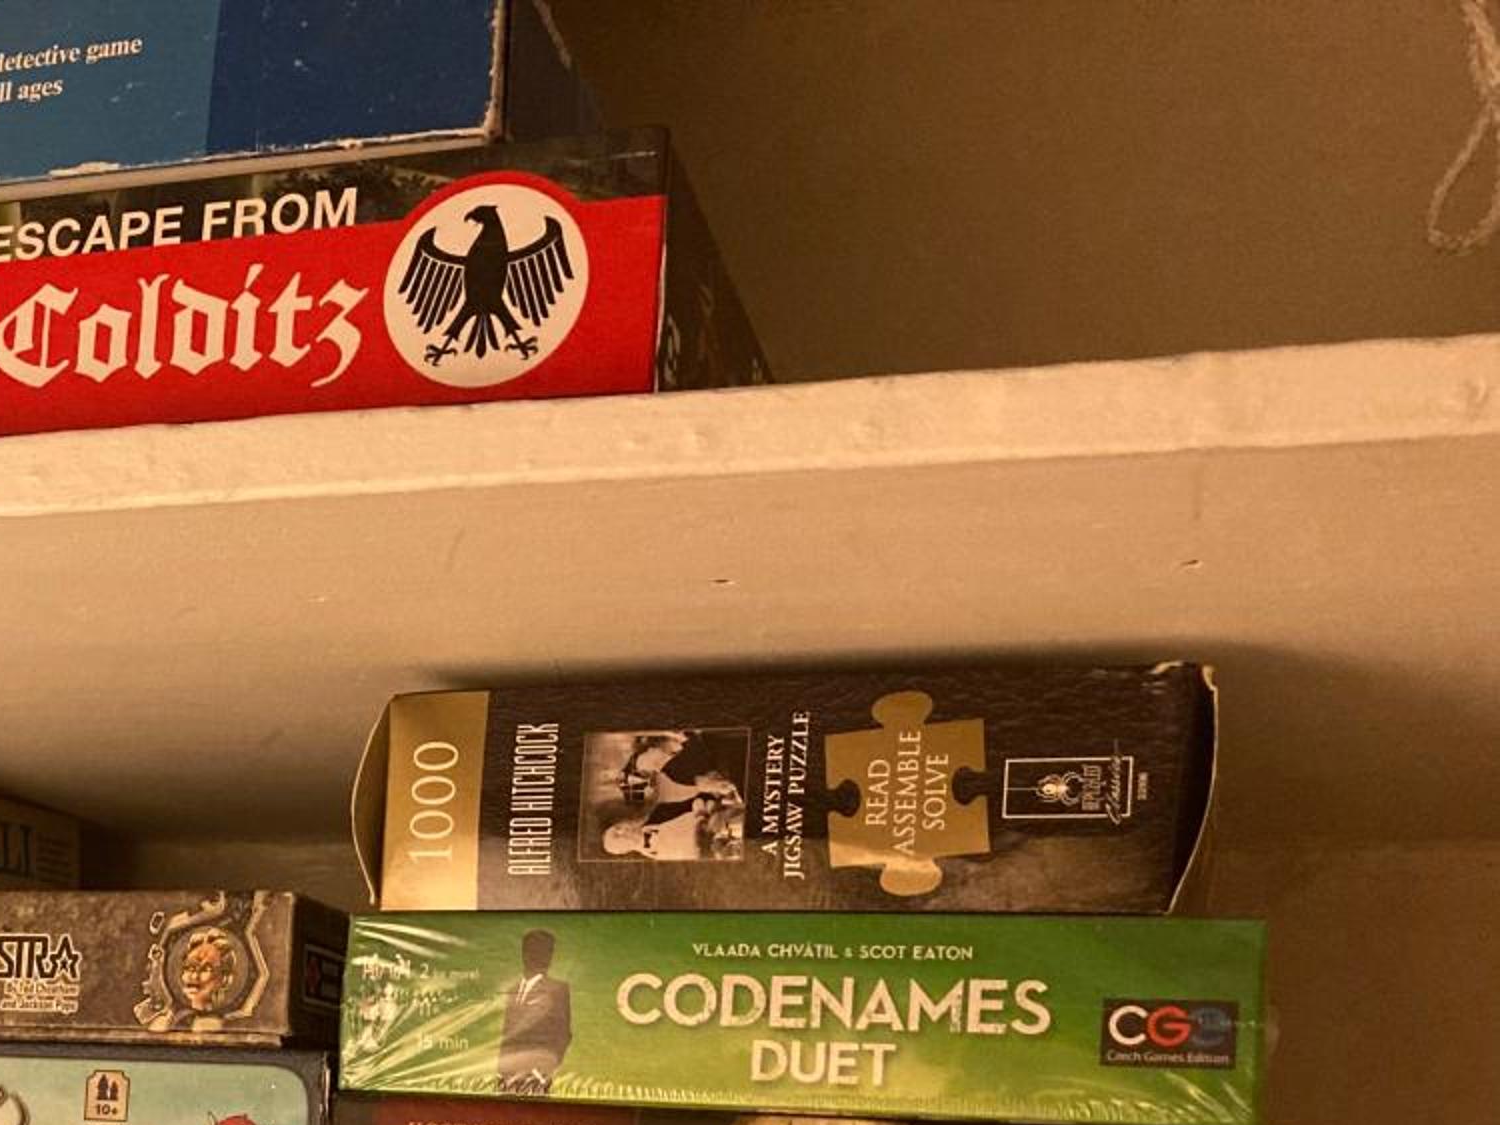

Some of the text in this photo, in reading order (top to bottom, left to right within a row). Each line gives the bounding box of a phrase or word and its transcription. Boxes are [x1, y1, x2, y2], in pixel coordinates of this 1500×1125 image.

[86, 37, 143, 62] game
[18, 77, 64, 102] ages
[202, 187, 359, 241] FROM
[406, 741, 460, 866] 1000
[507, 722, 560, 876] ALFRED HITCHCOCK
[759, 734, 786, 857] A MYSTERY
[783, 710, 811, 882] JIGSAW PUZZLE
[865, 758, 892, 827] READ
[892, 729, 923, 857] ASSEMBLE
[922, 753, 950, 832] SOLVE
[692, 943, 761, 959] VLAADA
[766, 943, 839, 960] CHVÁTIL
[859, 944, 907, 960] SCOT
[912, 945, 973, 961] EATON
[616, 973, 1053, 1036] CODENAMES
[438, 1037, 470, 1050] min
[750, 1039, 896, 1086] DUET
[95, 1103, 119, 1116] 10+
